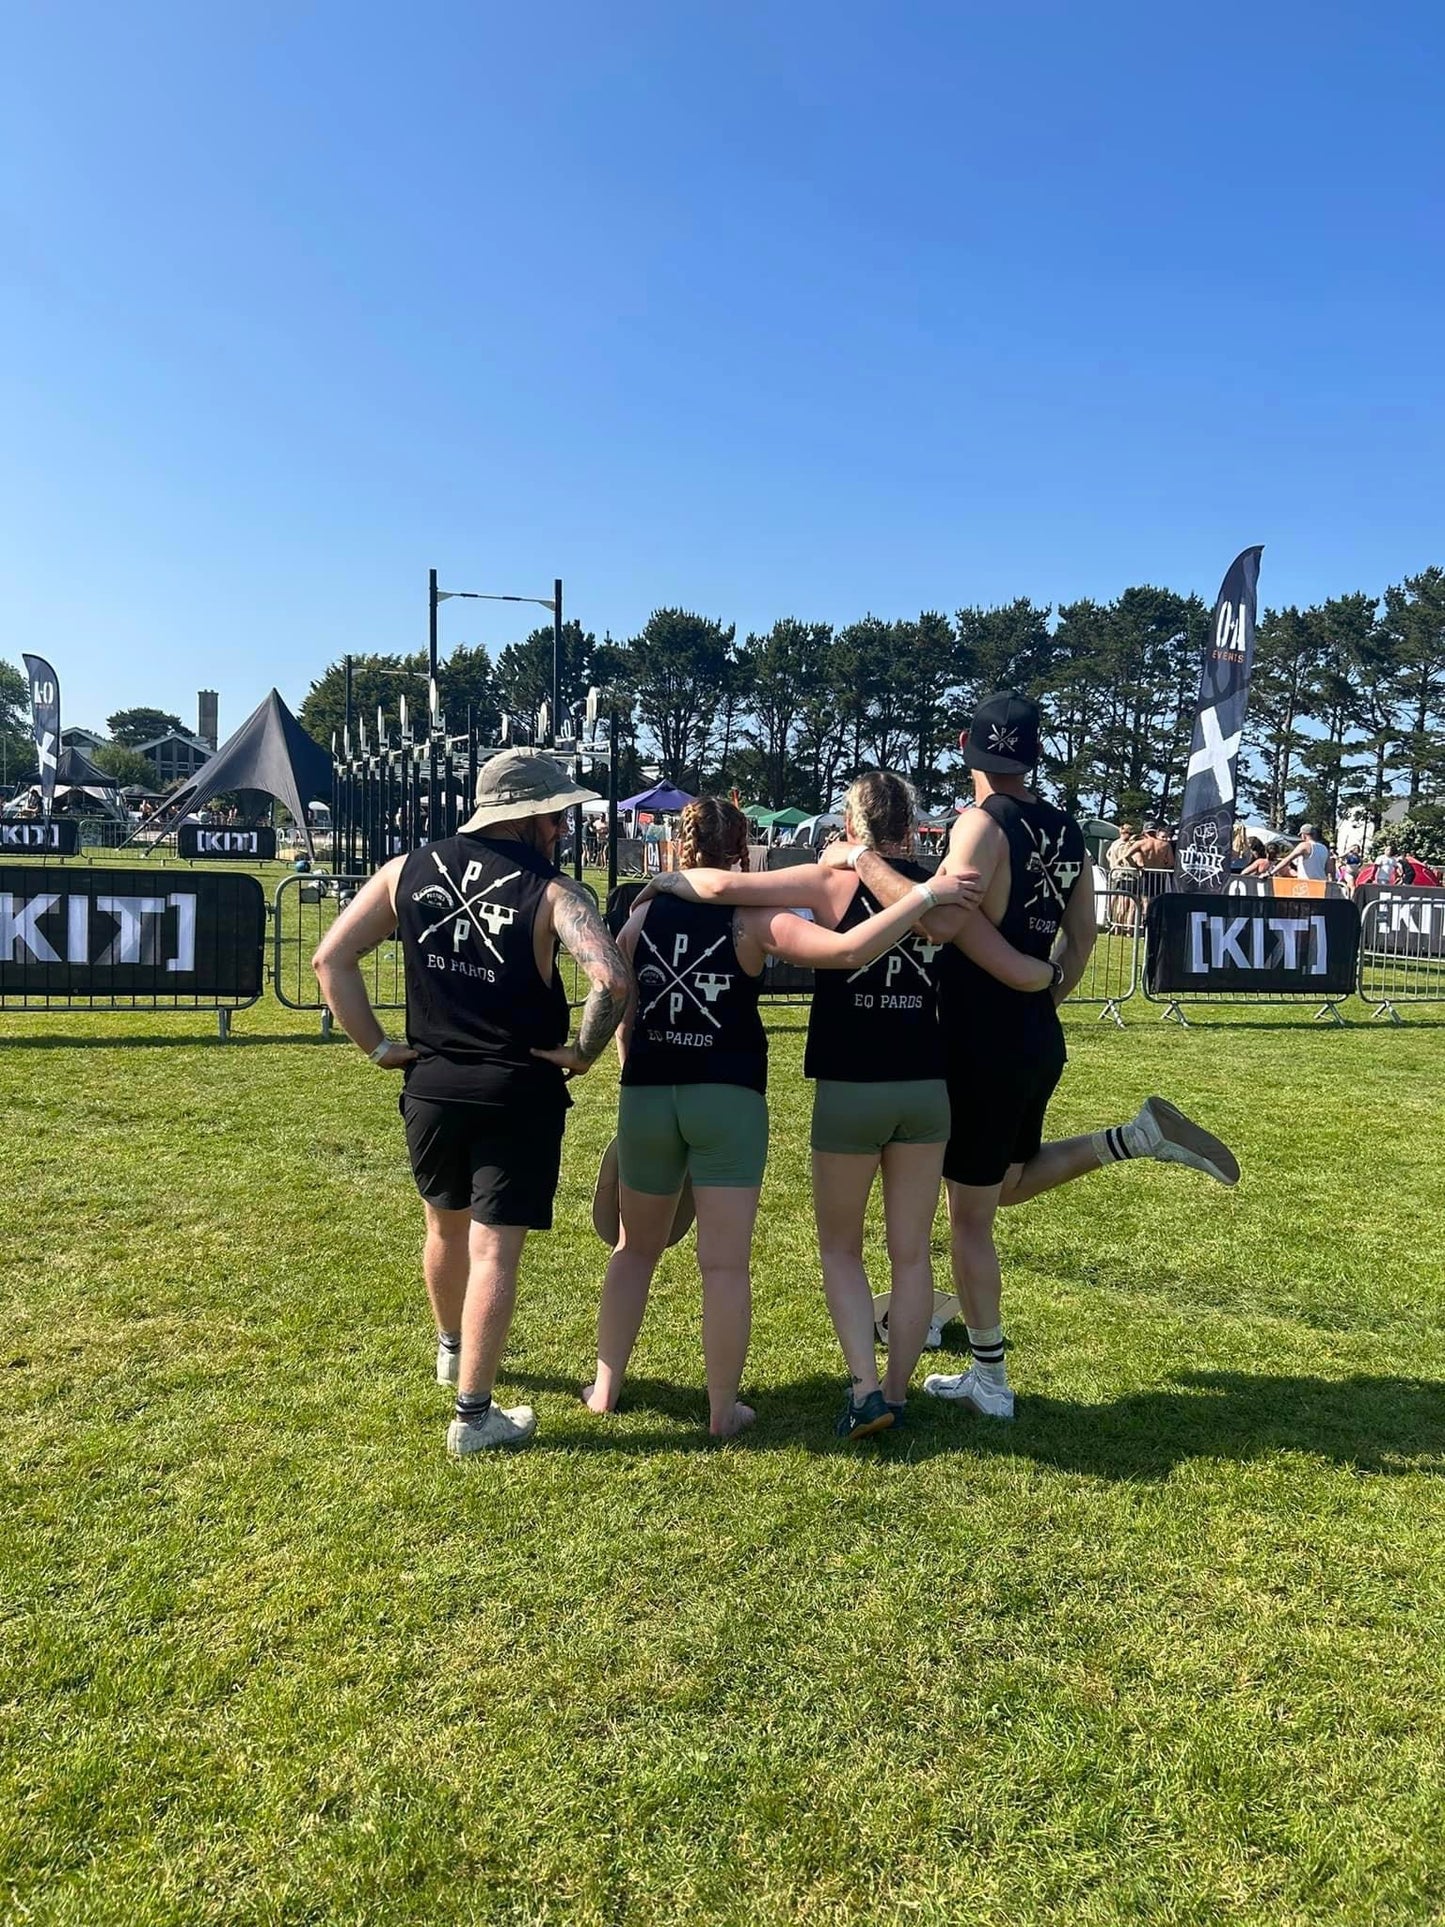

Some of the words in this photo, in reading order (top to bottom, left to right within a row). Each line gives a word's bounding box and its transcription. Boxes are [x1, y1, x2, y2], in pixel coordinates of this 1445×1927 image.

[1211, 649, 1245, 664] EVENTS
[1181, 847, 1223, 869] UNITE
[461, 859, 483, 894] P
[453, 918, 471, 953] P
[672, 933, 688, 967] P
[450, 958, 496, 983] PARDS
[885, 955, 902, 987] P
[669, 992, 684, 1025] P
[854, 993, 874, 1009] EQ
[880, 994, 923, 1009] PARDS
[665, 1030, 714, 1047] PARDS
